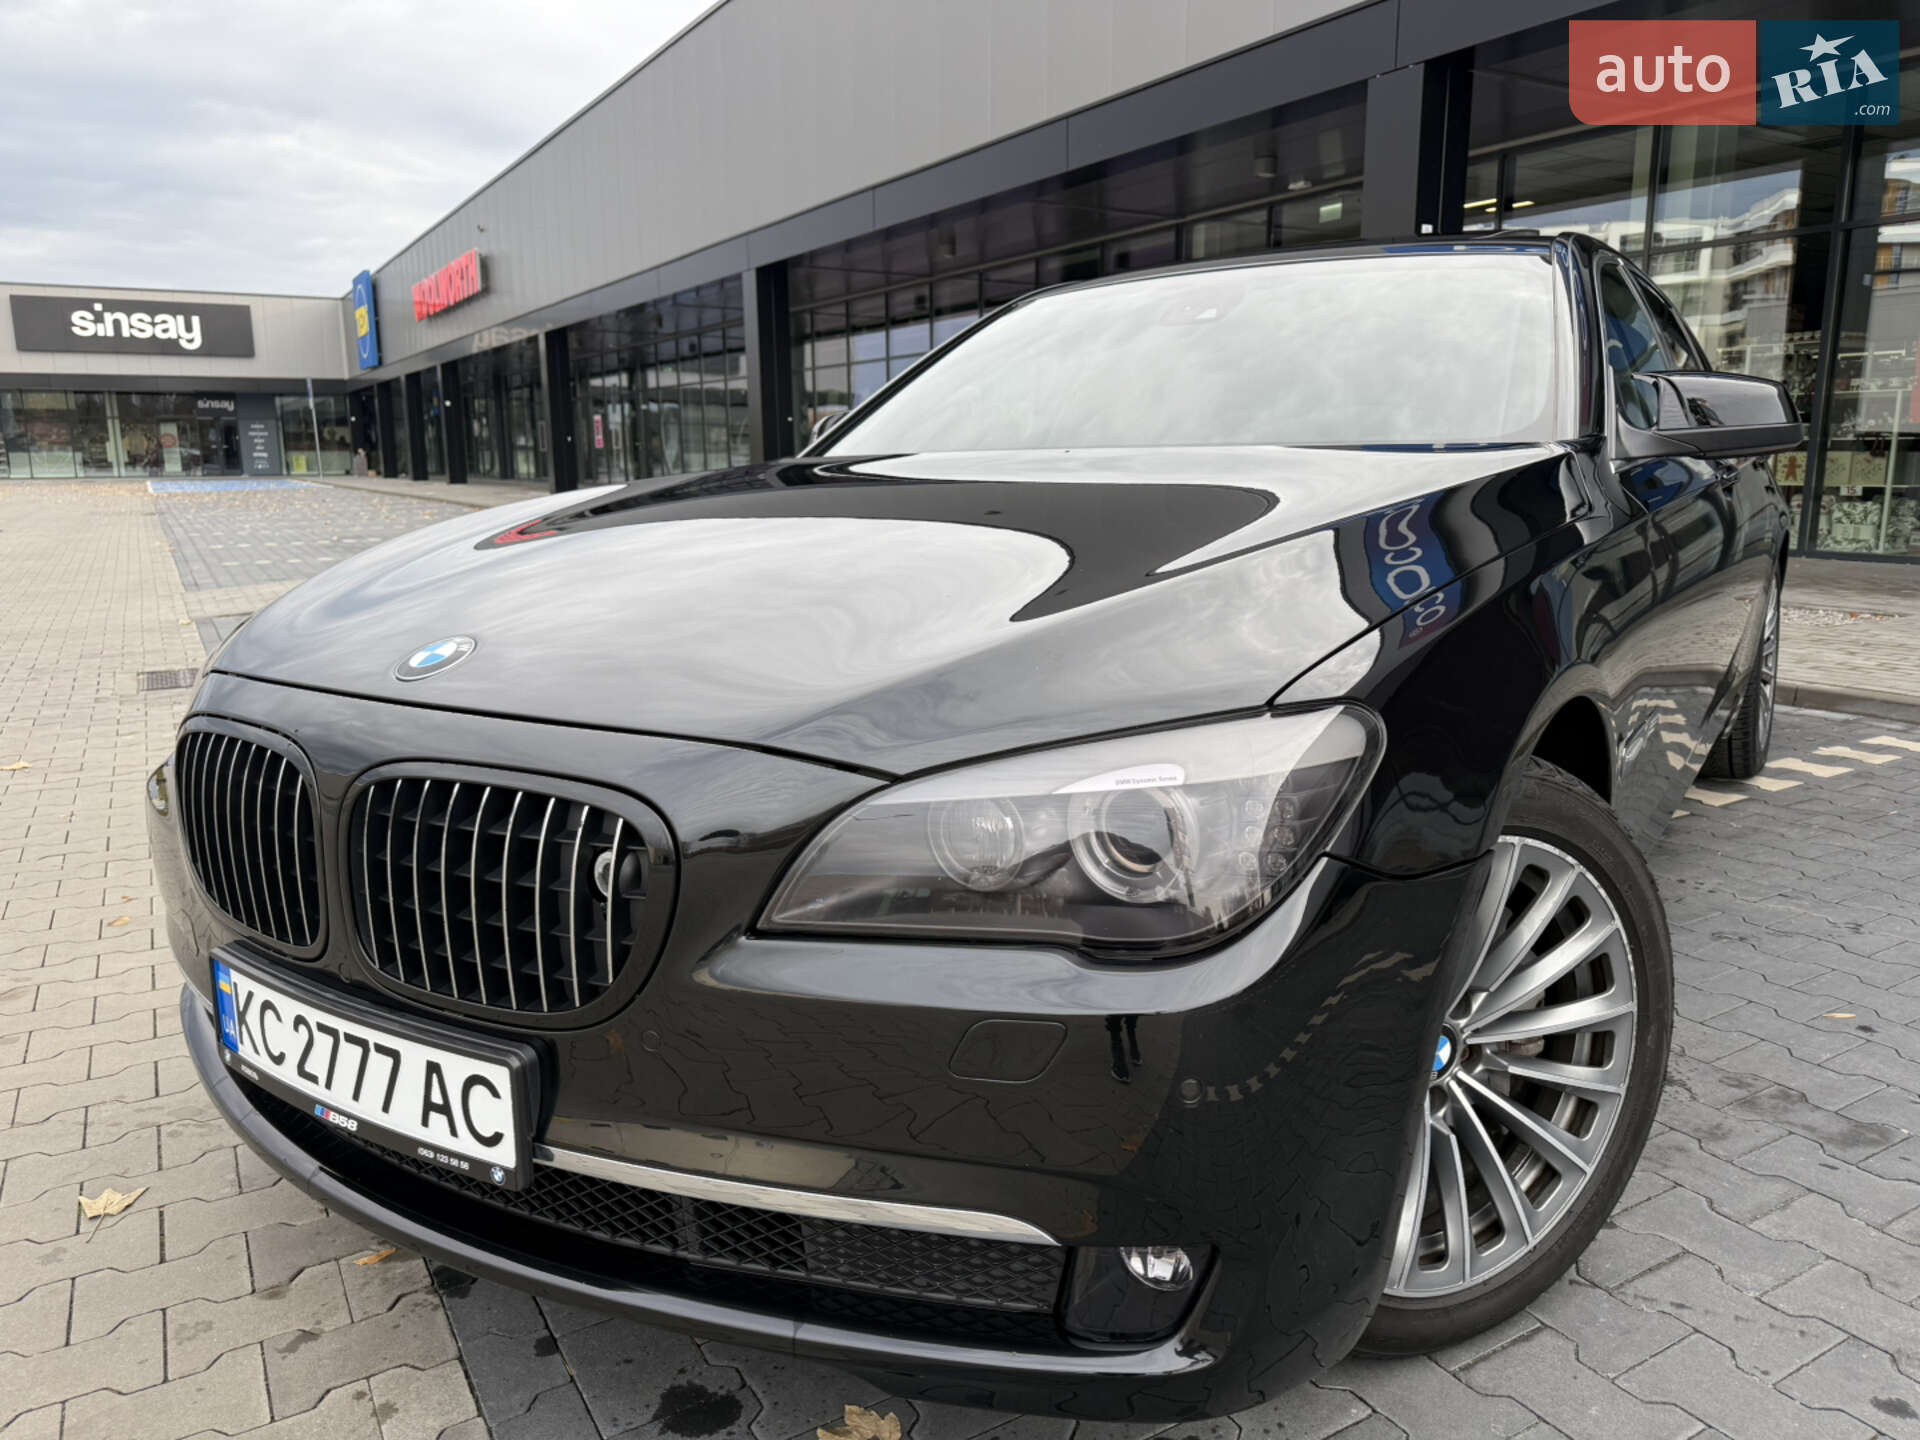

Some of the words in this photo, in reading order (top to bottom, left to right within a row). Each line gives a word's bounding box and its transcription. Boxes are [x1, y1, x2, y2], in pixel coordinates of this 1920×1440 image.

[71, 303, 202, 350] sinsay
[197, 398, 234, 411] sinsay
[233, 981, 286, 1067] KC
[293, 1014, 401, 1115] 2777
[420, 1058, 505, 1148] AC
